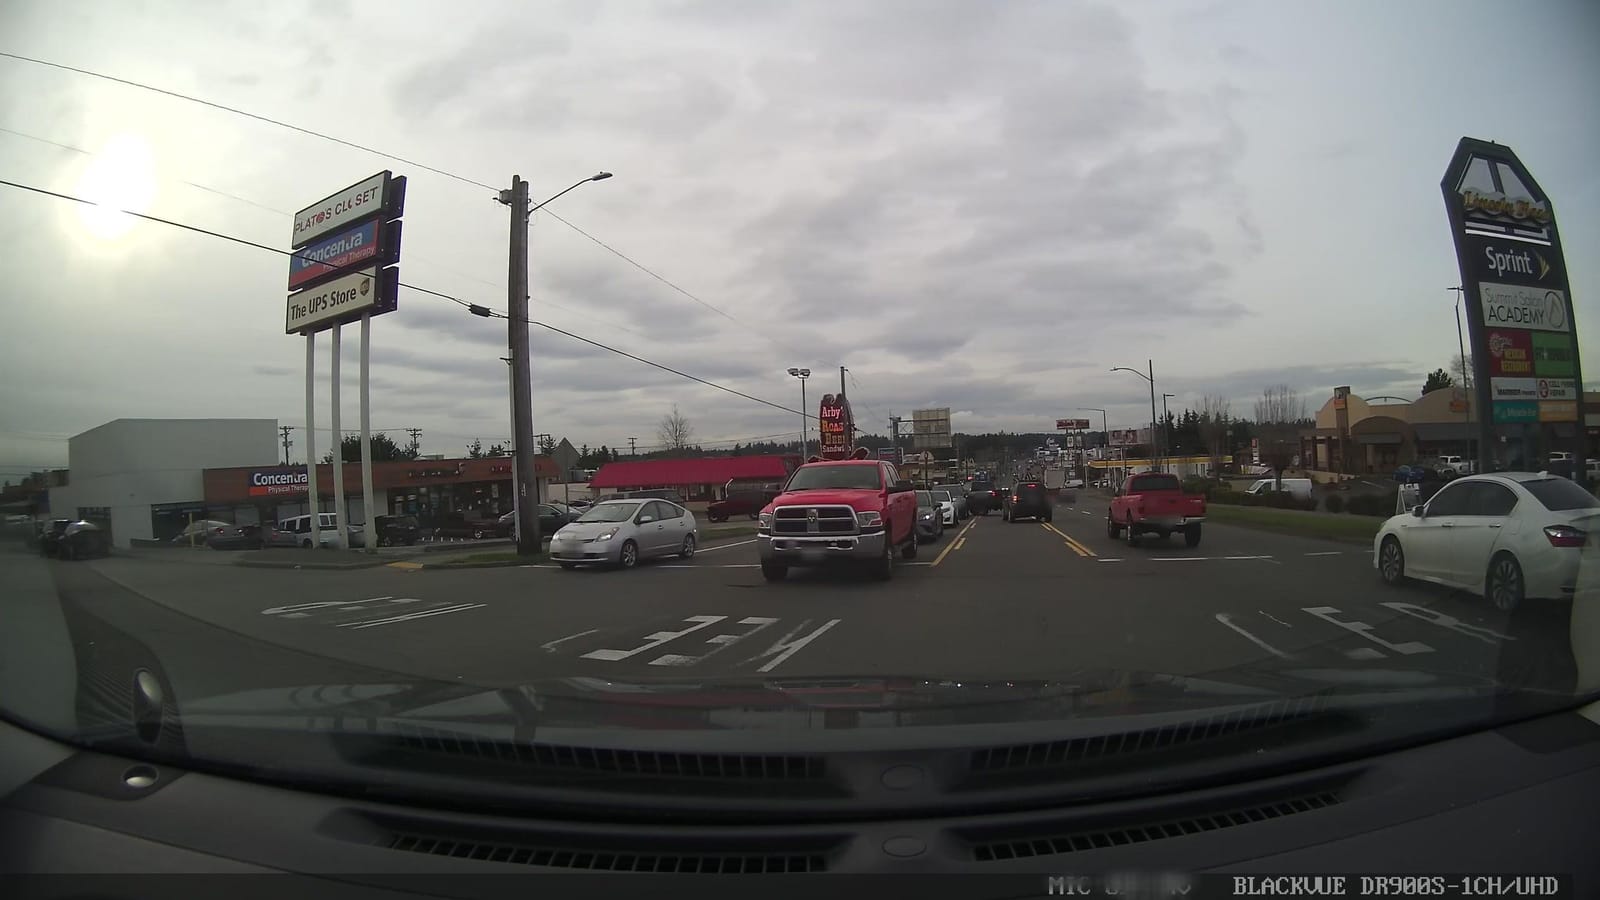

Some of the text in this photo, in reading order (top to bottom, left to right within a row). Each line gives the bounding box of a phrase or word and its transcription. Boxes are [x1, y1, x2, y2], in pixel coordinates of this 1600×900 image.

[1485, 246, 1533, 277] Sprint
[291, 303, 306, 321] The
[308, 295, 327, 315] UPS
[330, 287, 357, 308] Store
[1485, 288, 1545, 308] Summit Salon
[1488, 305, 1545, 325] ACADEMY
[822, 406, 844, 419] Arby'
[821, 420, 844, 432] ROAS
[253, 472, 308, 486] Concentra
